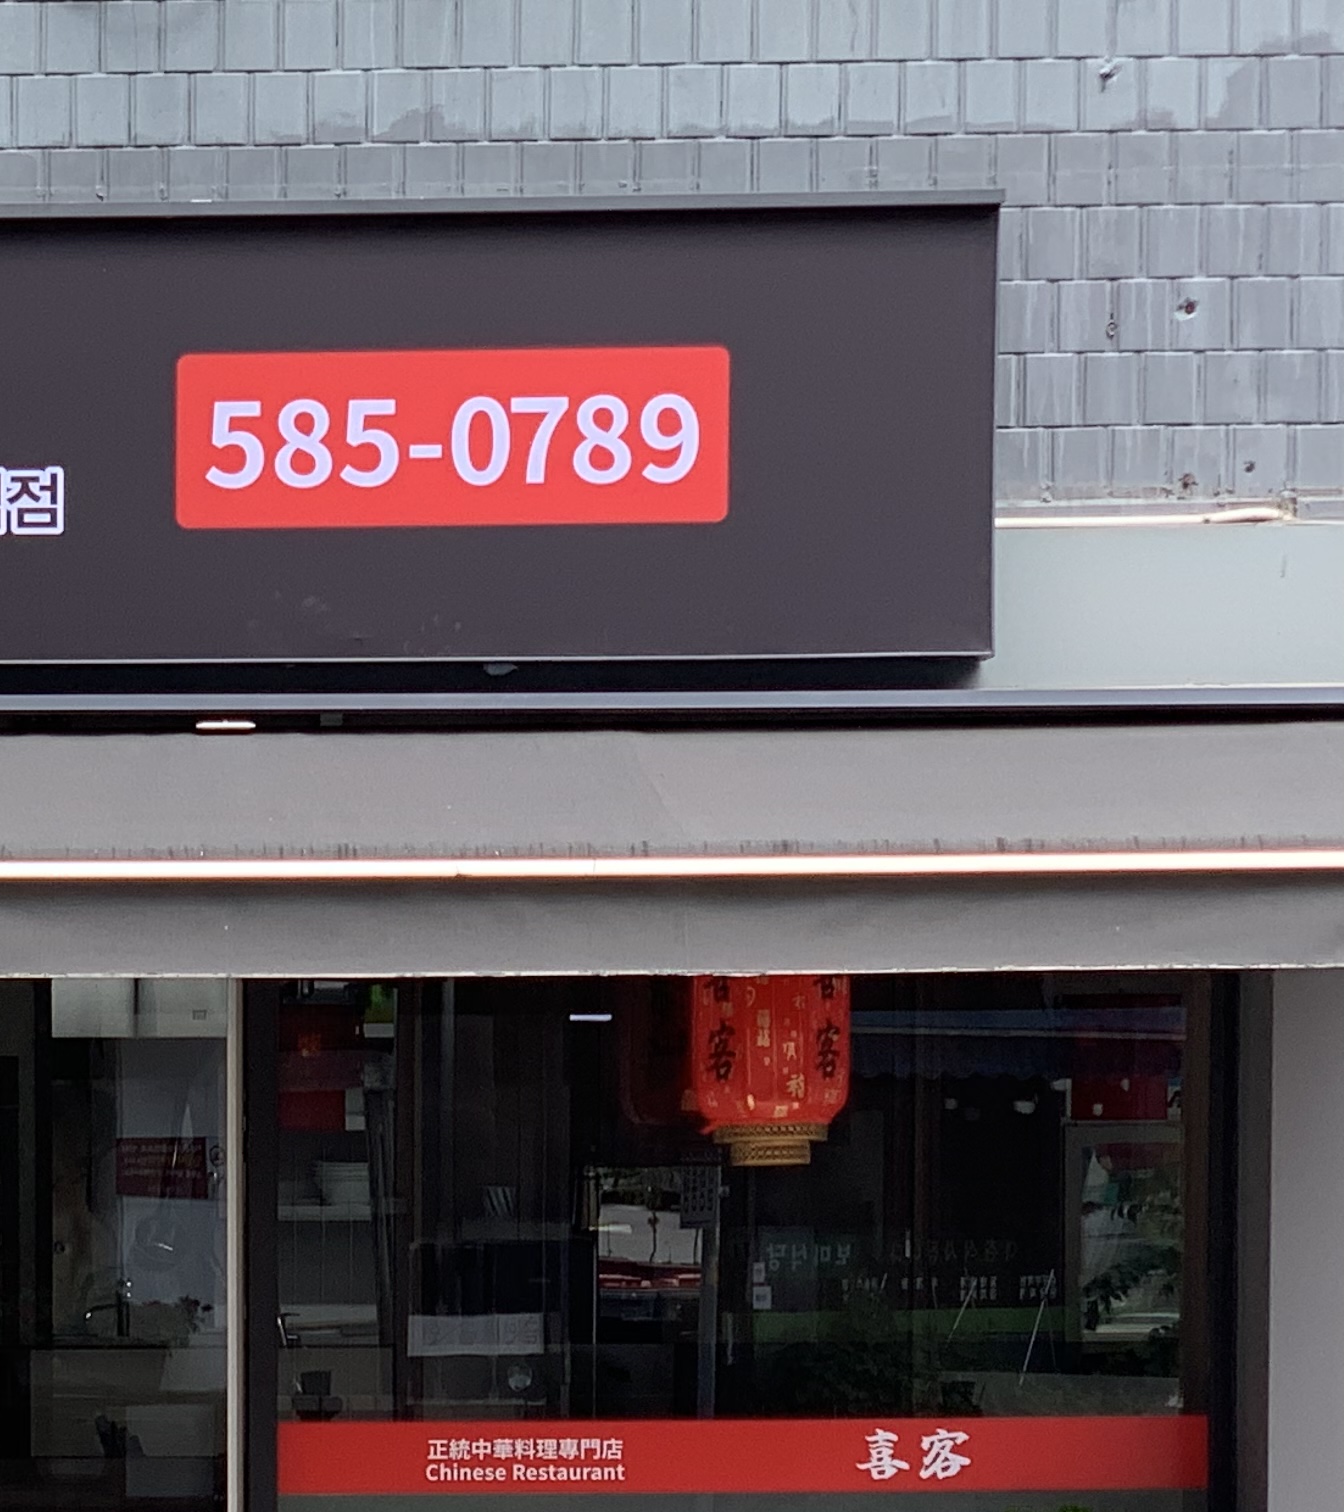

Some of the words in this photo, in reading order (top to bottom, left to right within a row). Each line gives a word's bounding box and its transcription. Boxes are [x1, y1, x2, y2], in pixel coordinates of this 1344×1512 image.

[204, 394, 702, 491] 585-0789
[427, 1438, 625, 1462] 正統中華料理專門店
[855, 1429, 973, 1482] 喜客
[425, 1463, 508, 1482] Chinese
[512, 1463, 627, 1482] Restaurant
